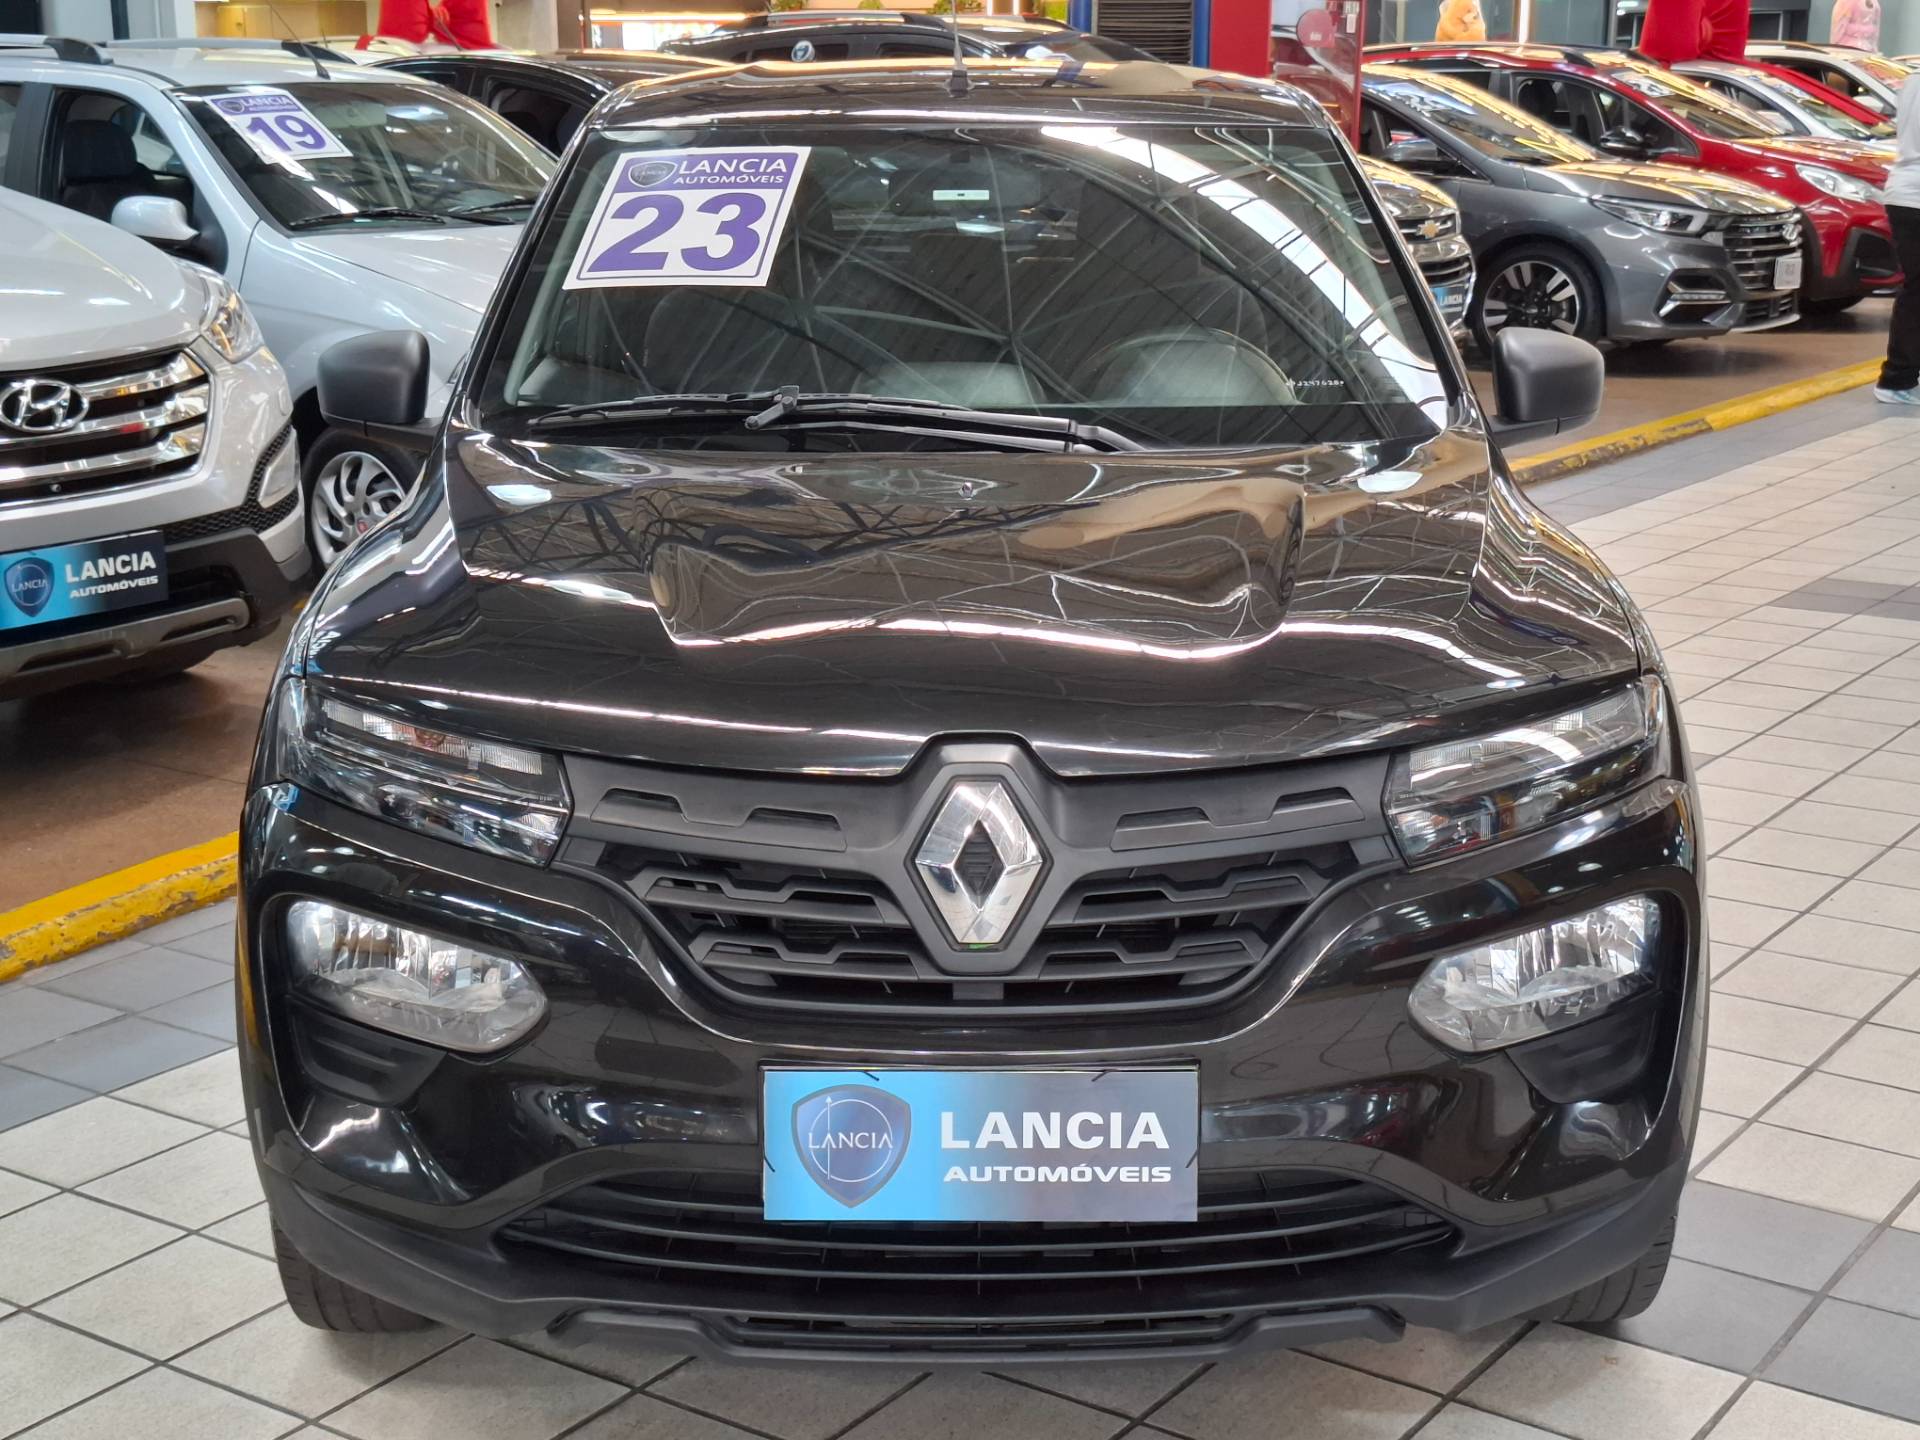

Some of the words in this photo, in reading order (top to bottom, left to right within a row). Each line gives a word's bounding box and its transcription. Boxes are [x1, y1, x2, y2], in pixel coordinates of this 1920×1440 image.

[240, 96, 295, 106] LANCIA
[247, 114, 326, 152] 19
[678, 158, 787, 175] LANCIA
[673, 173, 785, 185] AUTOMÓVEIS
[586, 192, 767, 273] 23
[64, 551, 157, 584] LANCIA
[11, 578, 49, 593] LANCIA
[69, 575, 159, 599] AUTOMÓVEIS
[940, 1111, 1171, 1150] LANCIA
[808, 1132, 894, 1150] LANCIA
[943, 1163, 1172, 1183] AUTOMÓVEIS
